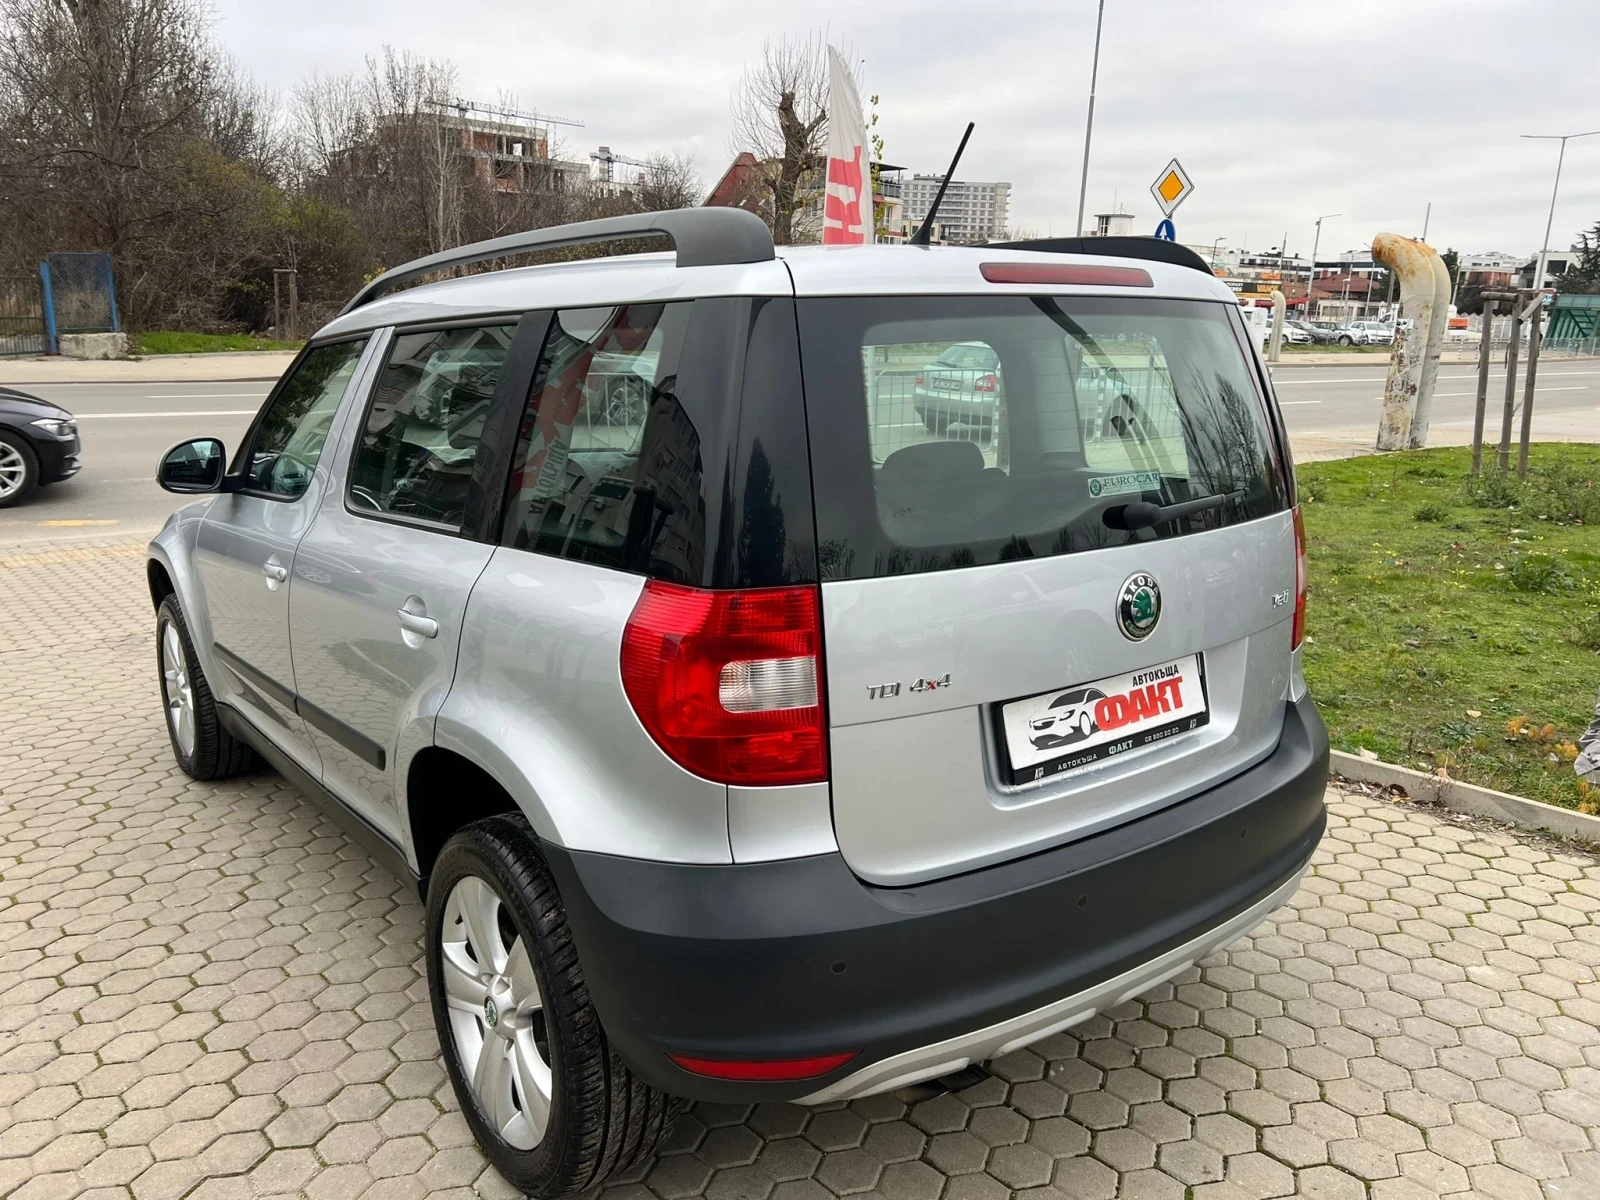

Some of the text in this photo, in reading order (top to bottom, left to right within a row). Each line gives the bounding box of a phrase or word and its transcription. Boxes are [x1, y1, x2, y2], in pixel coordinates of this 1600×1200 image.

[1103, 473, 1159, 487] EUROCAR
[866, 672, 952, 700] TDI 4x4
[1132, 664, 1180, 687] АВТОКЪЩА
[1094, 676, 1183, 731] ФАКТ
[1108, 739, 1133, 755] ФАКТ
